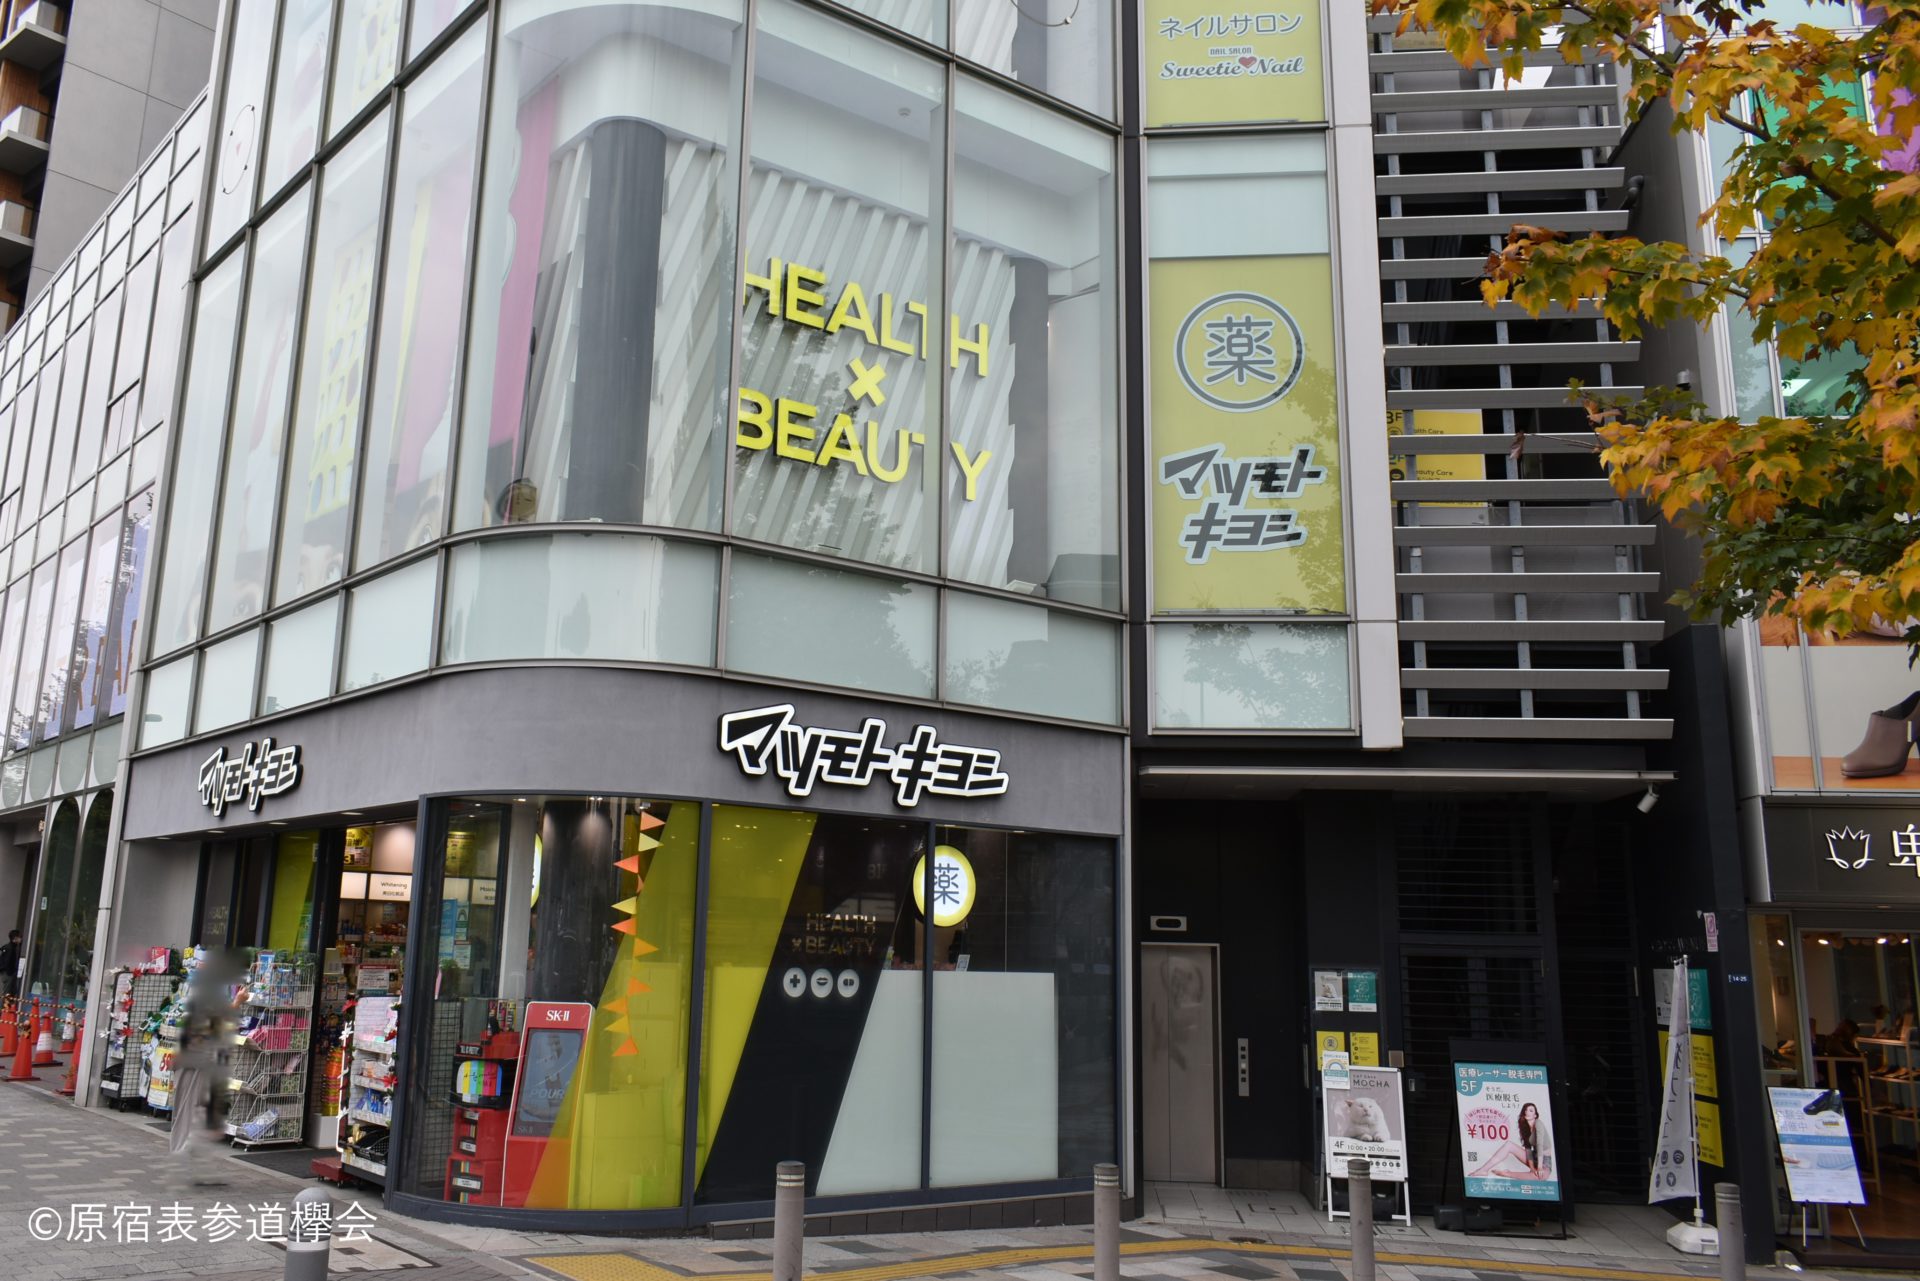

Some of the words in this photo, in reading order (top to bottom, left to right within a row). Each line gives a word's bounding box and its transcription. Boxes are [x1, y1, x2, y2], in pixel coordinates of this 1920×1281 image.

[1160, 14, 1301, 38] ネイルサロン
[1161, 62, 1243, 77] Sweetie
[1250, 57, 1303, 73] Nail
[1206, 316, 1276, 382] 薬
[1163, 448, 1322, 506] マツモト
[1184, 503, 1302, 559] キヨシ
[722, 704, 1009, 806] マツモトキヨシ
[198, 738, 298, 817] マツモトキヨシ
[934, 863, 960, 904] 薬
[806, 913, 876, 933] HEALTH
[546, 1010, 570, 1021] SK-II
[1352, 1079, 1390, 1088] MOCHA
[1461, 1081, 1477, 1091] 5F
[1486, 1094, 1520, 1102] 医療脱毛
[1467, 1124, 1509, 1140] ¥100
[1334, 1141, 1344, 1149] 4F
